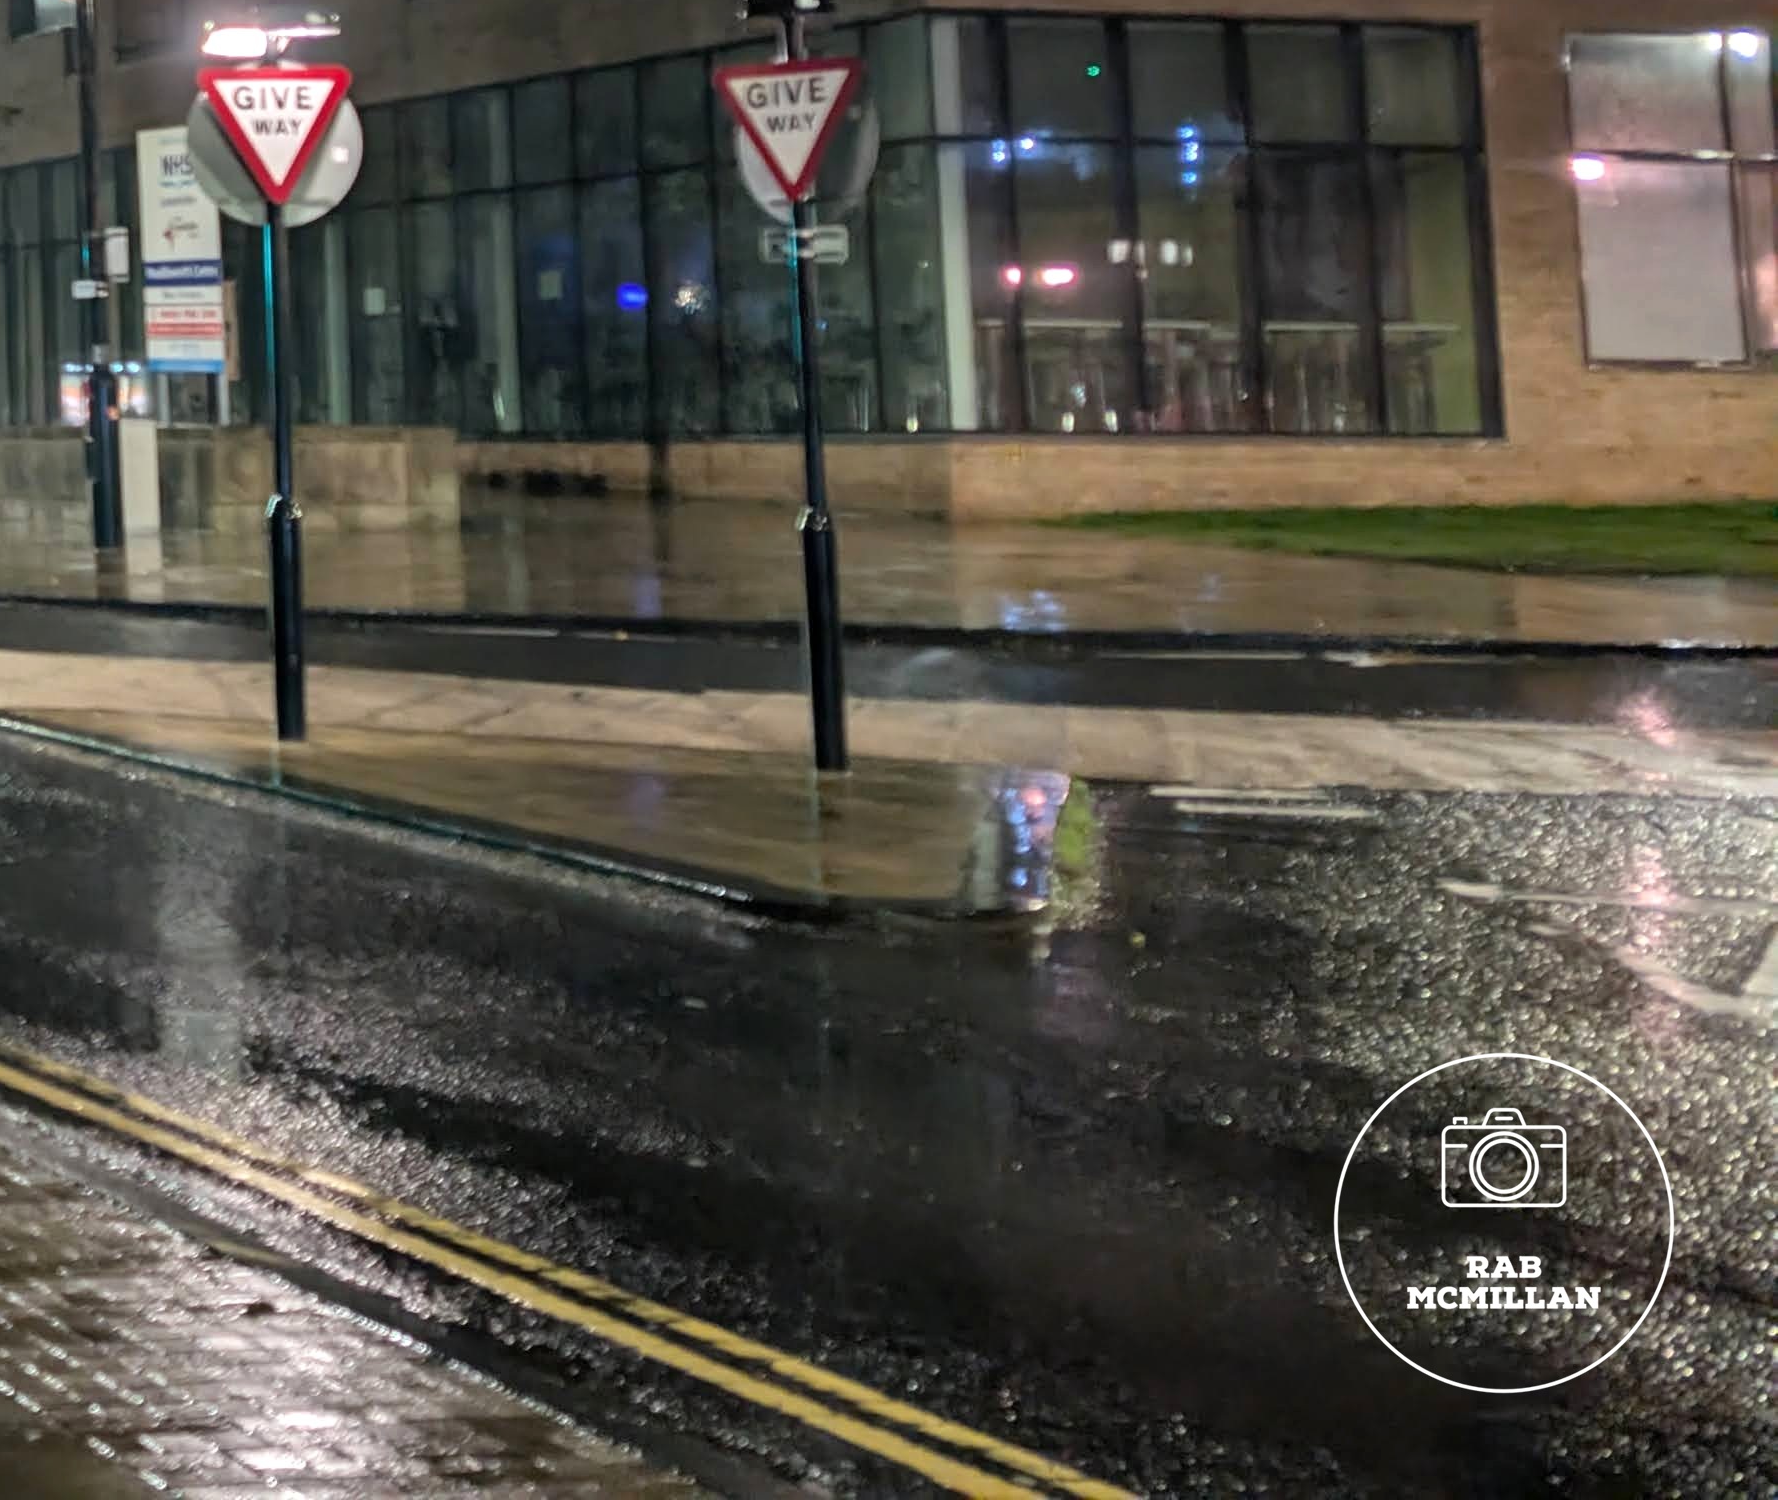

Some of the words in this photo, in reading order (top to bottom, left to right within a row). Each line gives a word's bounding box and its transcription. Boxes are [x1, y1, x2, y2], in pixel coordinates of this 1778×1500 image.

[233, 86, 313, 110] GIVE
[747, 77, 827, 108] GIVE
[252, 119, 301, 135] WAY
[767, 114, 816, 134] WAY
